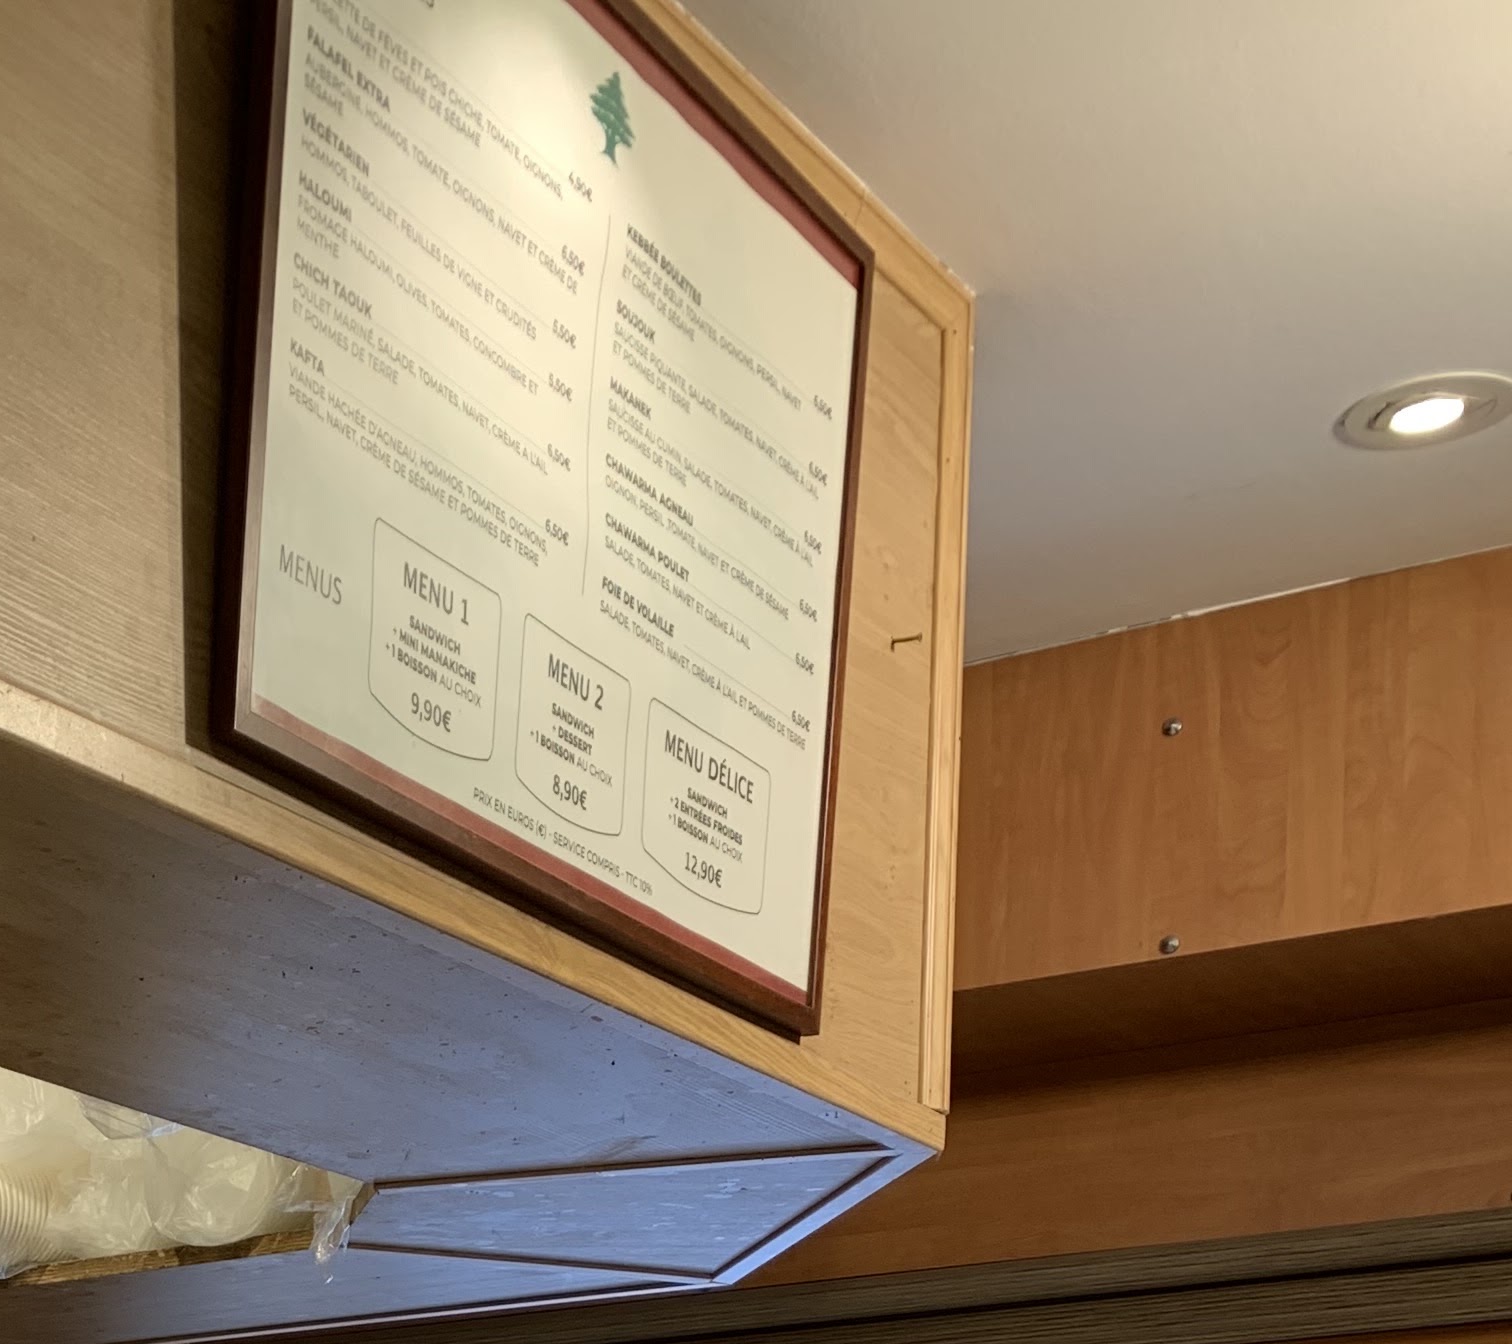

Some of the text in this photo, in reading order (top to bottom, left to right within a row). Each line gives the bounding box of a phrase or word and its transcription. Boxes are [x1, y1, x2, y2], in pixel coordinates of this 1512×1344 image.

[307, 23, 354, 79] FALAFEL
[356, 69, 390, 112] EXTRA
[302, 106, 370, 178] VÉGÉTARIEN
[298, 168, 352, 225] HALOUMI
[292, 275, 331, 318] POULET
[293, 250, 329, 291] CHICH
[332, 276, 372, 321] TAOUK
[292, 297, 398, 387] ET POMMES DE TERRE
[288, 362, 325, 401] VIANDE
[327, 388, 366, 430] HACHÉE
[610, 376, 651, 421] MAKANEK
[290, 337, 569, 547] KAFTA 6,50€
[360, 431, 391, 469] CRÈME
[393, 457, 406, 479] DE
[408, 464, 445, 505] SÉSAME
[447, 494, 458, 513] ET
[460, 502, 498, 540] POMMES
[500, 529, 512, 549] DE
[513, 538, 539, 567] TERRE
[605, 450, 657, 503] CHAWARMA
[659, 490, 693, 527] AGNEAU
[278, 542, 343, 607] MENUS
[605, 511, 655, 559] CHAWARMA
[657, 549, 689, 583] POULET
[403, 561, 470, 626] MENU 1
[602, 574, 621, 601] FOIE
[623, 590, 634, 609] DE
[636, 600, 674, 638] VOLAILLE
[399, 628, 476, 686] MINI MANAKICHE
[409, 613, 460, 656] SANDWICH
[397, 648, 481, 708] BOISSON AU CHOIX
[547, 653, 604, 711] MENU 2
[691, 660, 715, 689] CRÈME
[739, 694, 746, 710] ET
[748, 700, 776, 730] POMMES
[777, 720, 785, 736] DE
[786, 727, 805, 750] TERRE
[410, 690, 451, 738] 9,90€
[551, 702, 594, 739] SANDWICH
[557, 725, 592, 757] DESSERT
[540, 734, 612, 787] BOISSON AU CHOIX
[664, 728, 754, 805] MENU DÉLICE
[552, 772, 587, 814] 8,90€
[680, 799, 742, 846] ENTRÉES FROIDES
[687, 785, 727, 820] SANDWICH
[473, 786, 492, 809] PRIX
[494, 798, 505, 815] EN
[507, 805, 534, 831] EUROS
[553, 830, 585, 859] SERVICE
[586, 848, 620, 878] COMPRIS
[677, 816, 742, 864] BOISSON AU CHOIX
[684, 850, 722, 891] 12,90€
